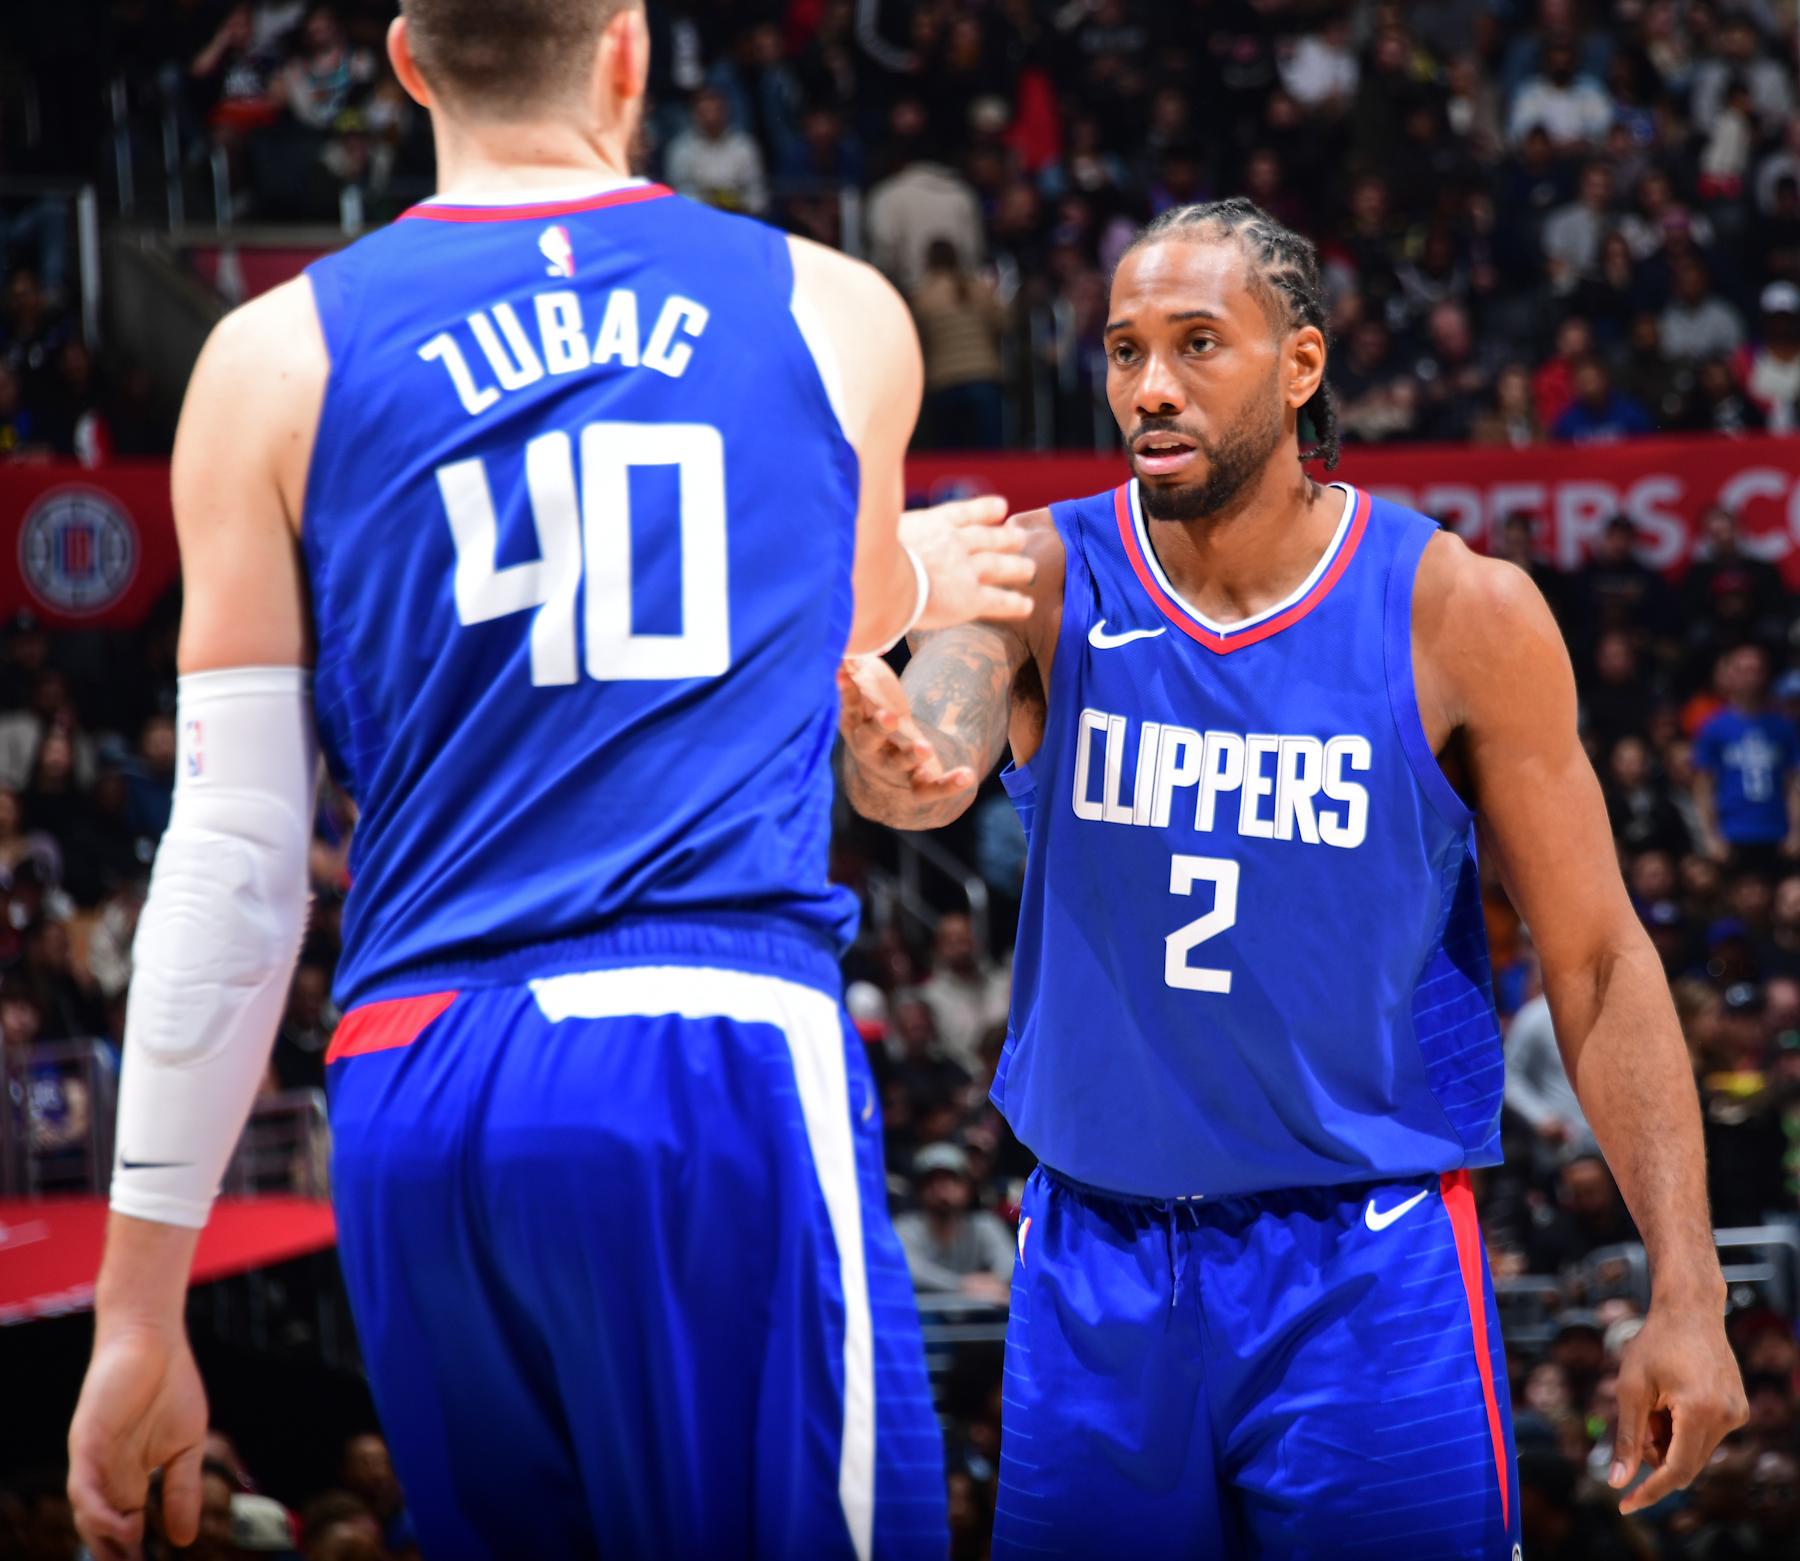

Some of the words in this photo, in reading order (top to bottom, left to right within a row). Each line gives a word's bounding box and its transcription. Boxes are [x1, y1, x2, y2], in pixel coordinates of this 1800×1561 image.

[417, 288, 710, 416] ZUBAC
[435, 420, 731, 687] 40
[1072, 707, 1372, 849] CLIPPERS
[1164, 853, 1240, 994] 2
